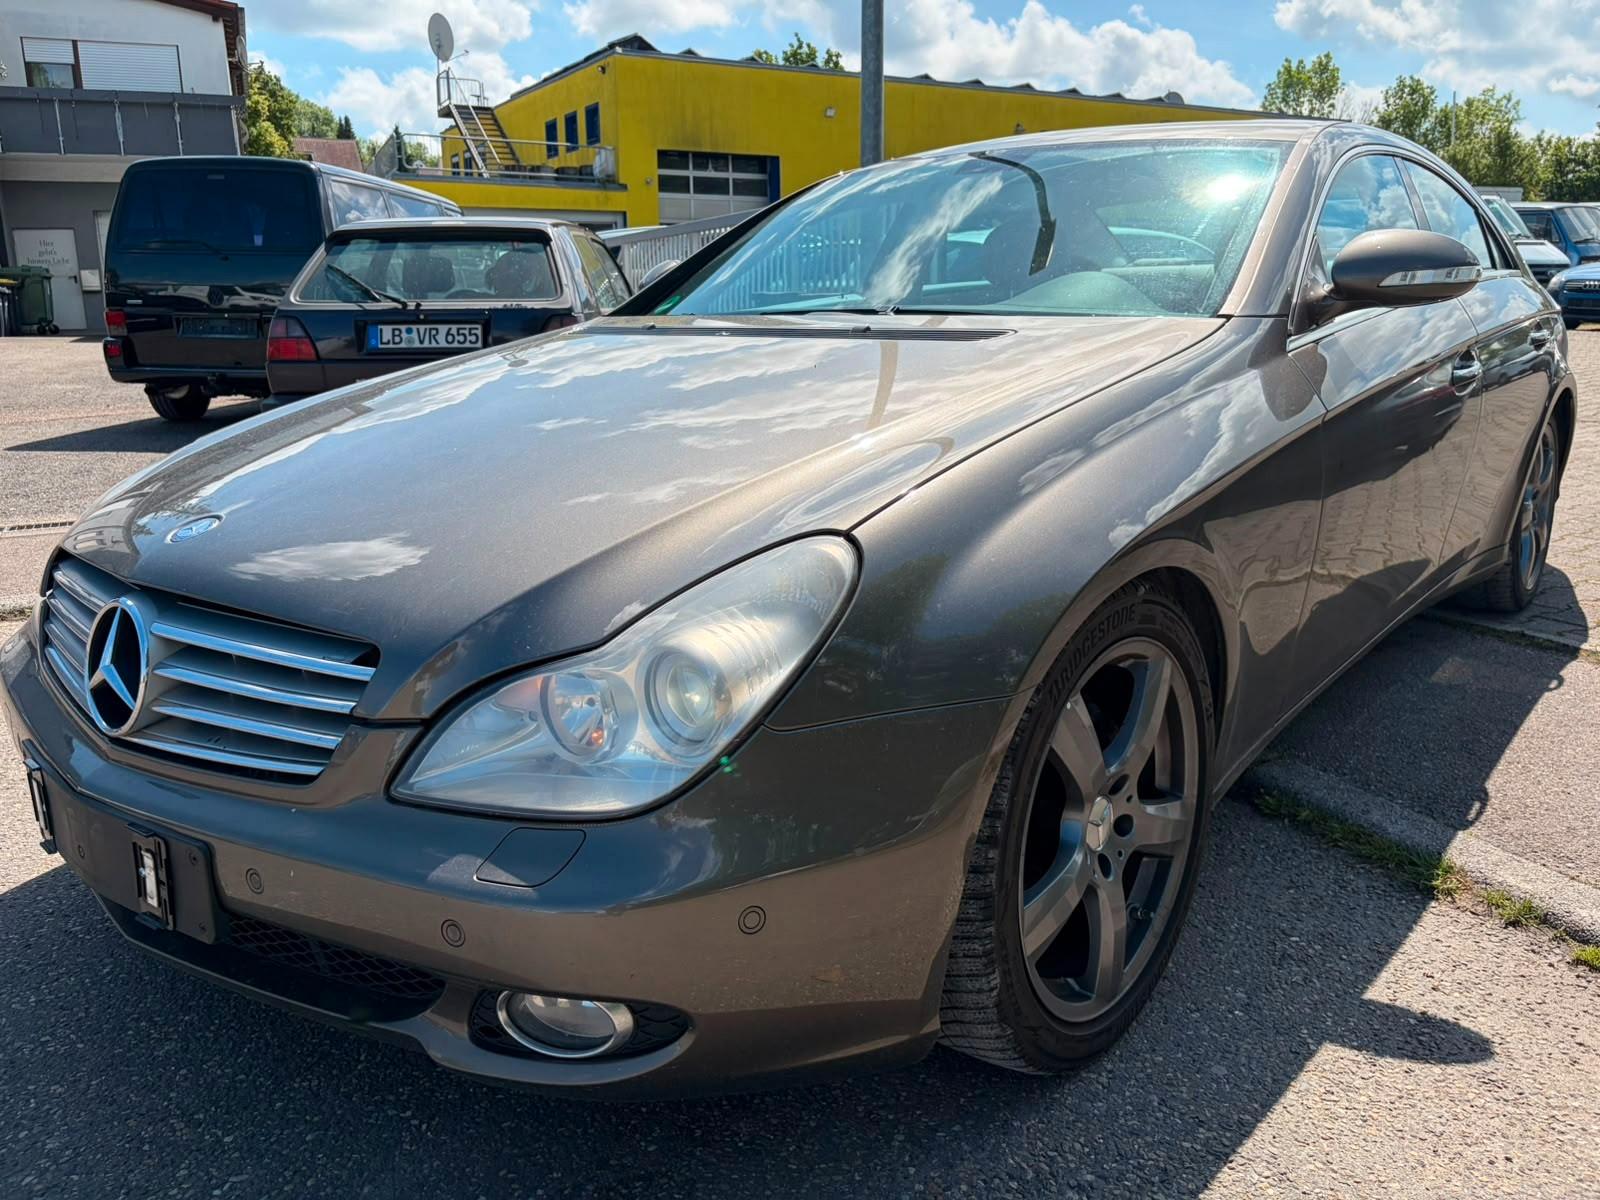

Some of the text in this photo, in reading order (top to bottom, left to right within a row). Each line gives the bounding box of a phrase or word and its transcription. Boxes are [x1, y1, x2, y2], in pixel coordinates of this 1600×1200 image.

[379, 327, 480, 346] LB VR 655
